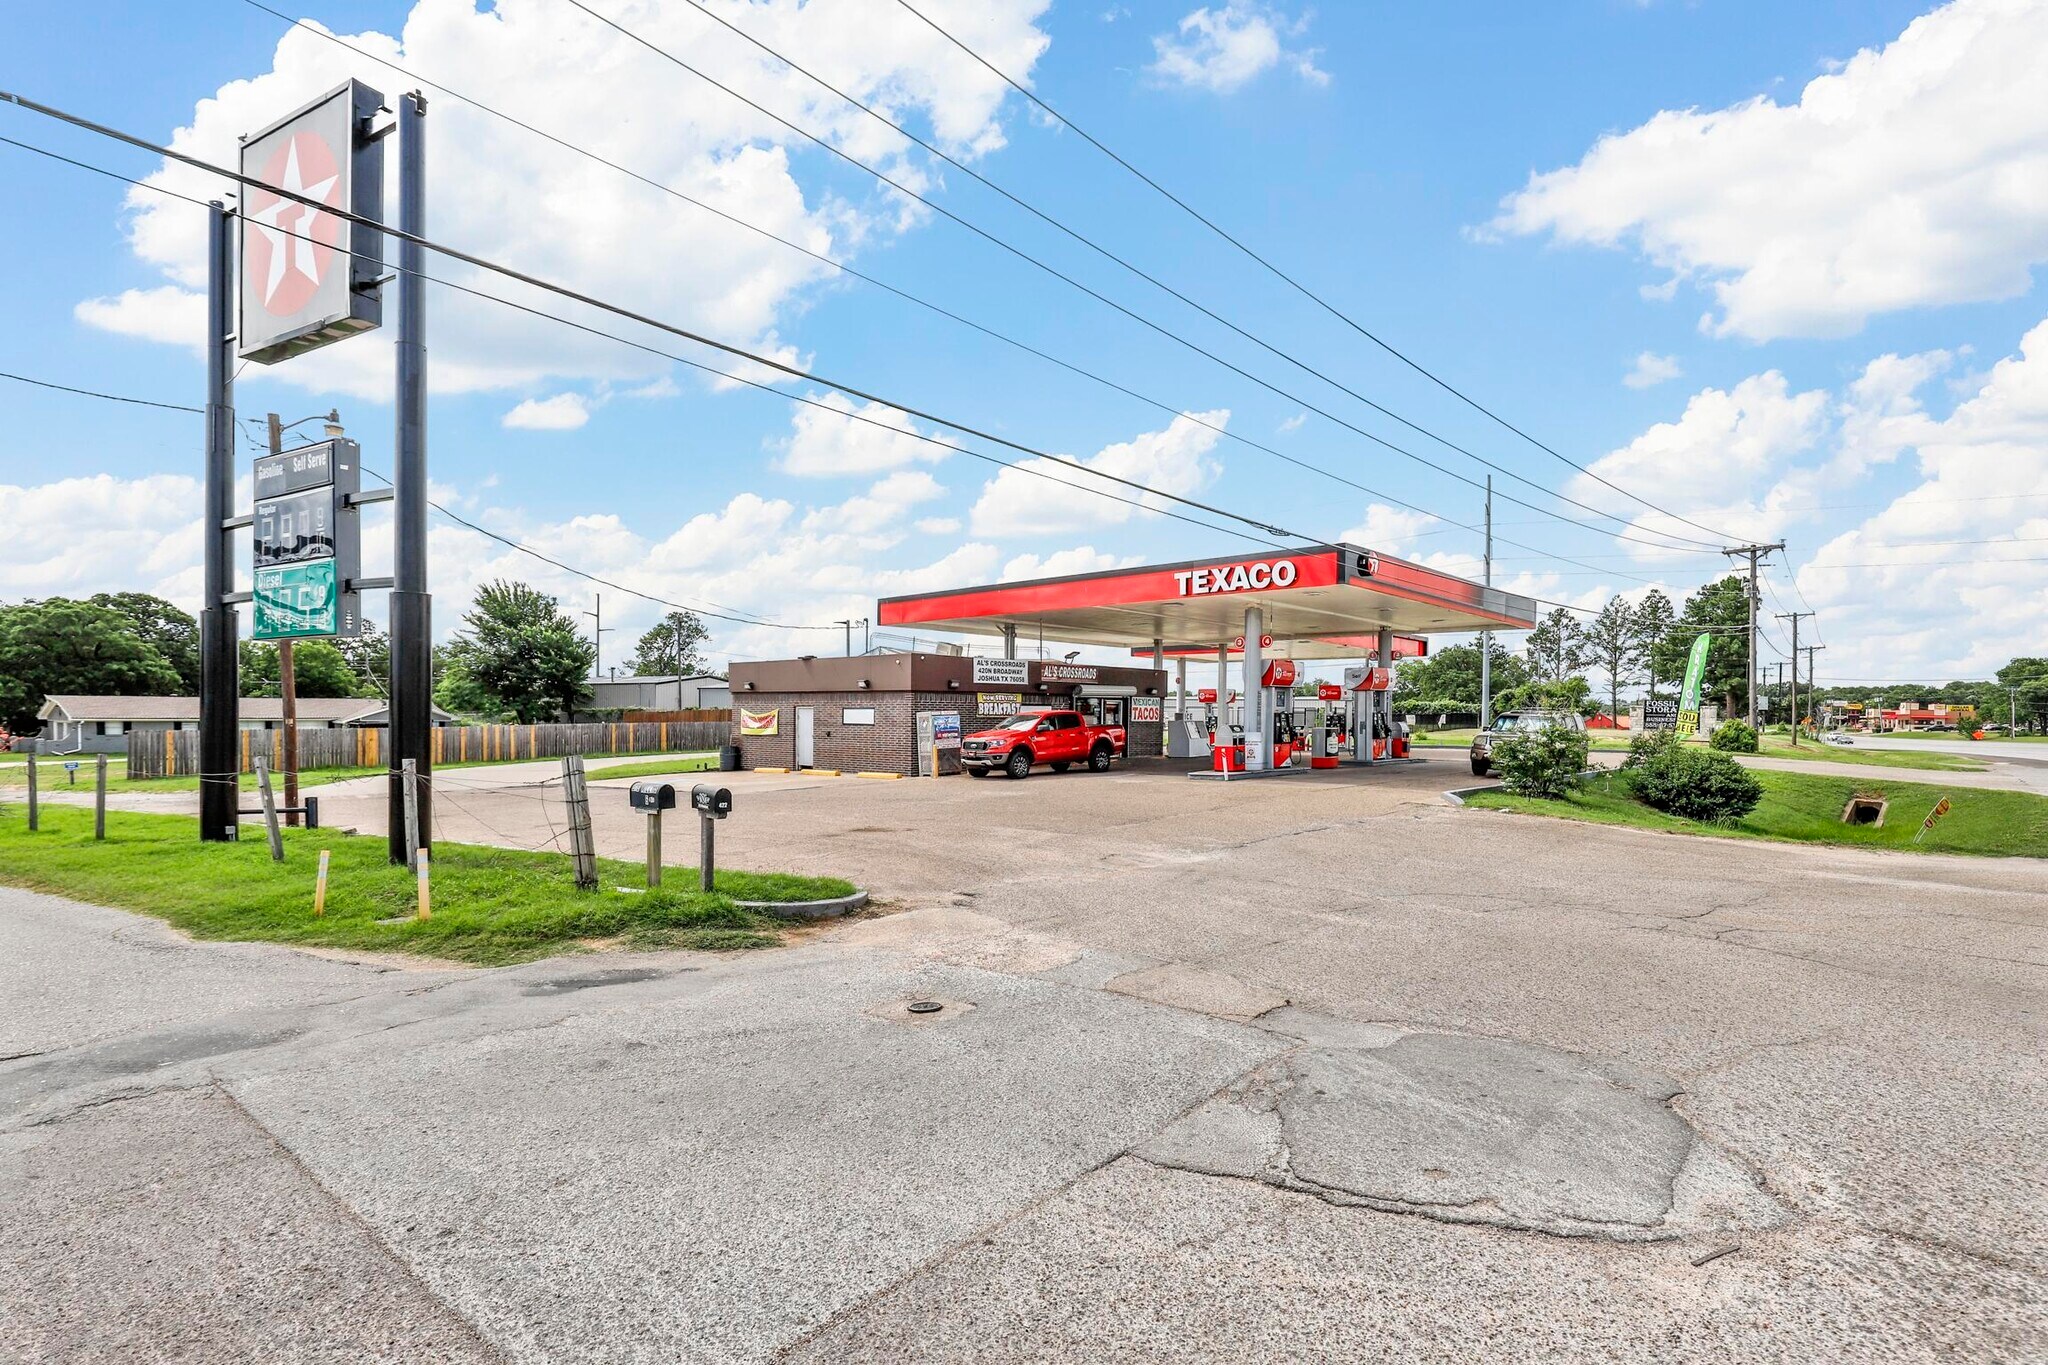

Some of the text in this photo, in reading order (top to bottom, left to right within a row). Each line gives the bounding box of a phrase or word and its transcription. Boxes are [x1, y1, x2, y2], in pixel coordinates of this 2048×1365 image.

[258, 453, 327, 480] Gasoline Self Serve
[258, 505, 277, 516] Regular
[258, 572, 282, 587] Diesel
[1174, 560, 1296, 595] TEXACO
[1043, 665, 1097, 679] AL'S CROSSROADS
[1132, 697, 1160, 706] MEXICAN
[978, 703, 1020, 716] BREAKFAST
[1132, 707, 1159, 720] TACOS
